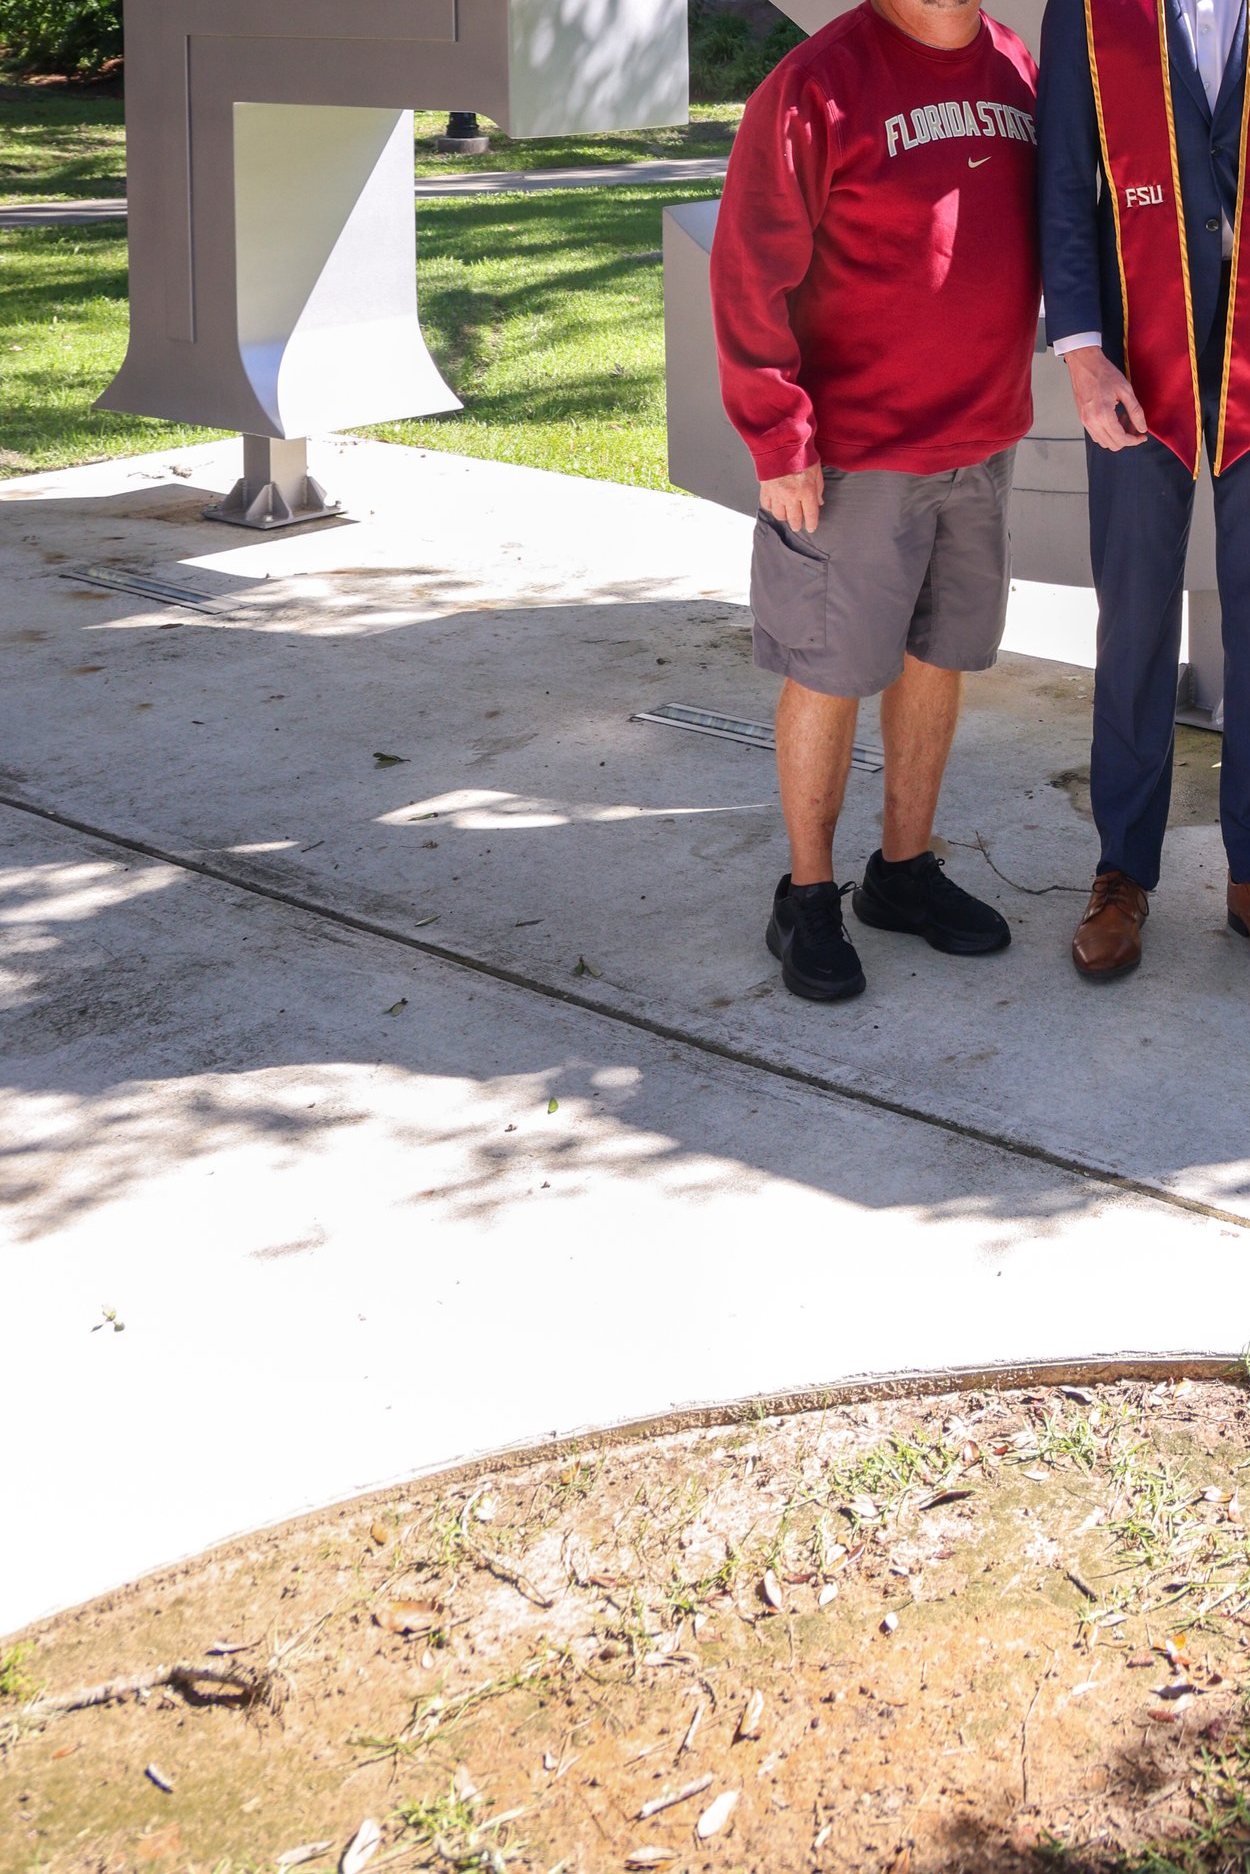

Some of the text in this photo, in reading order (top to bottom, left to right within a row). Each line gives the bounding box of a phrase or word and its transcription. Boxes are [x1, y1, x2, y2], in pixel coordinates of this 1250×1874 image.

[884, 100, 1038, 158] FLORIDA STATE
[1125, 184, 1164, 208] FSU
